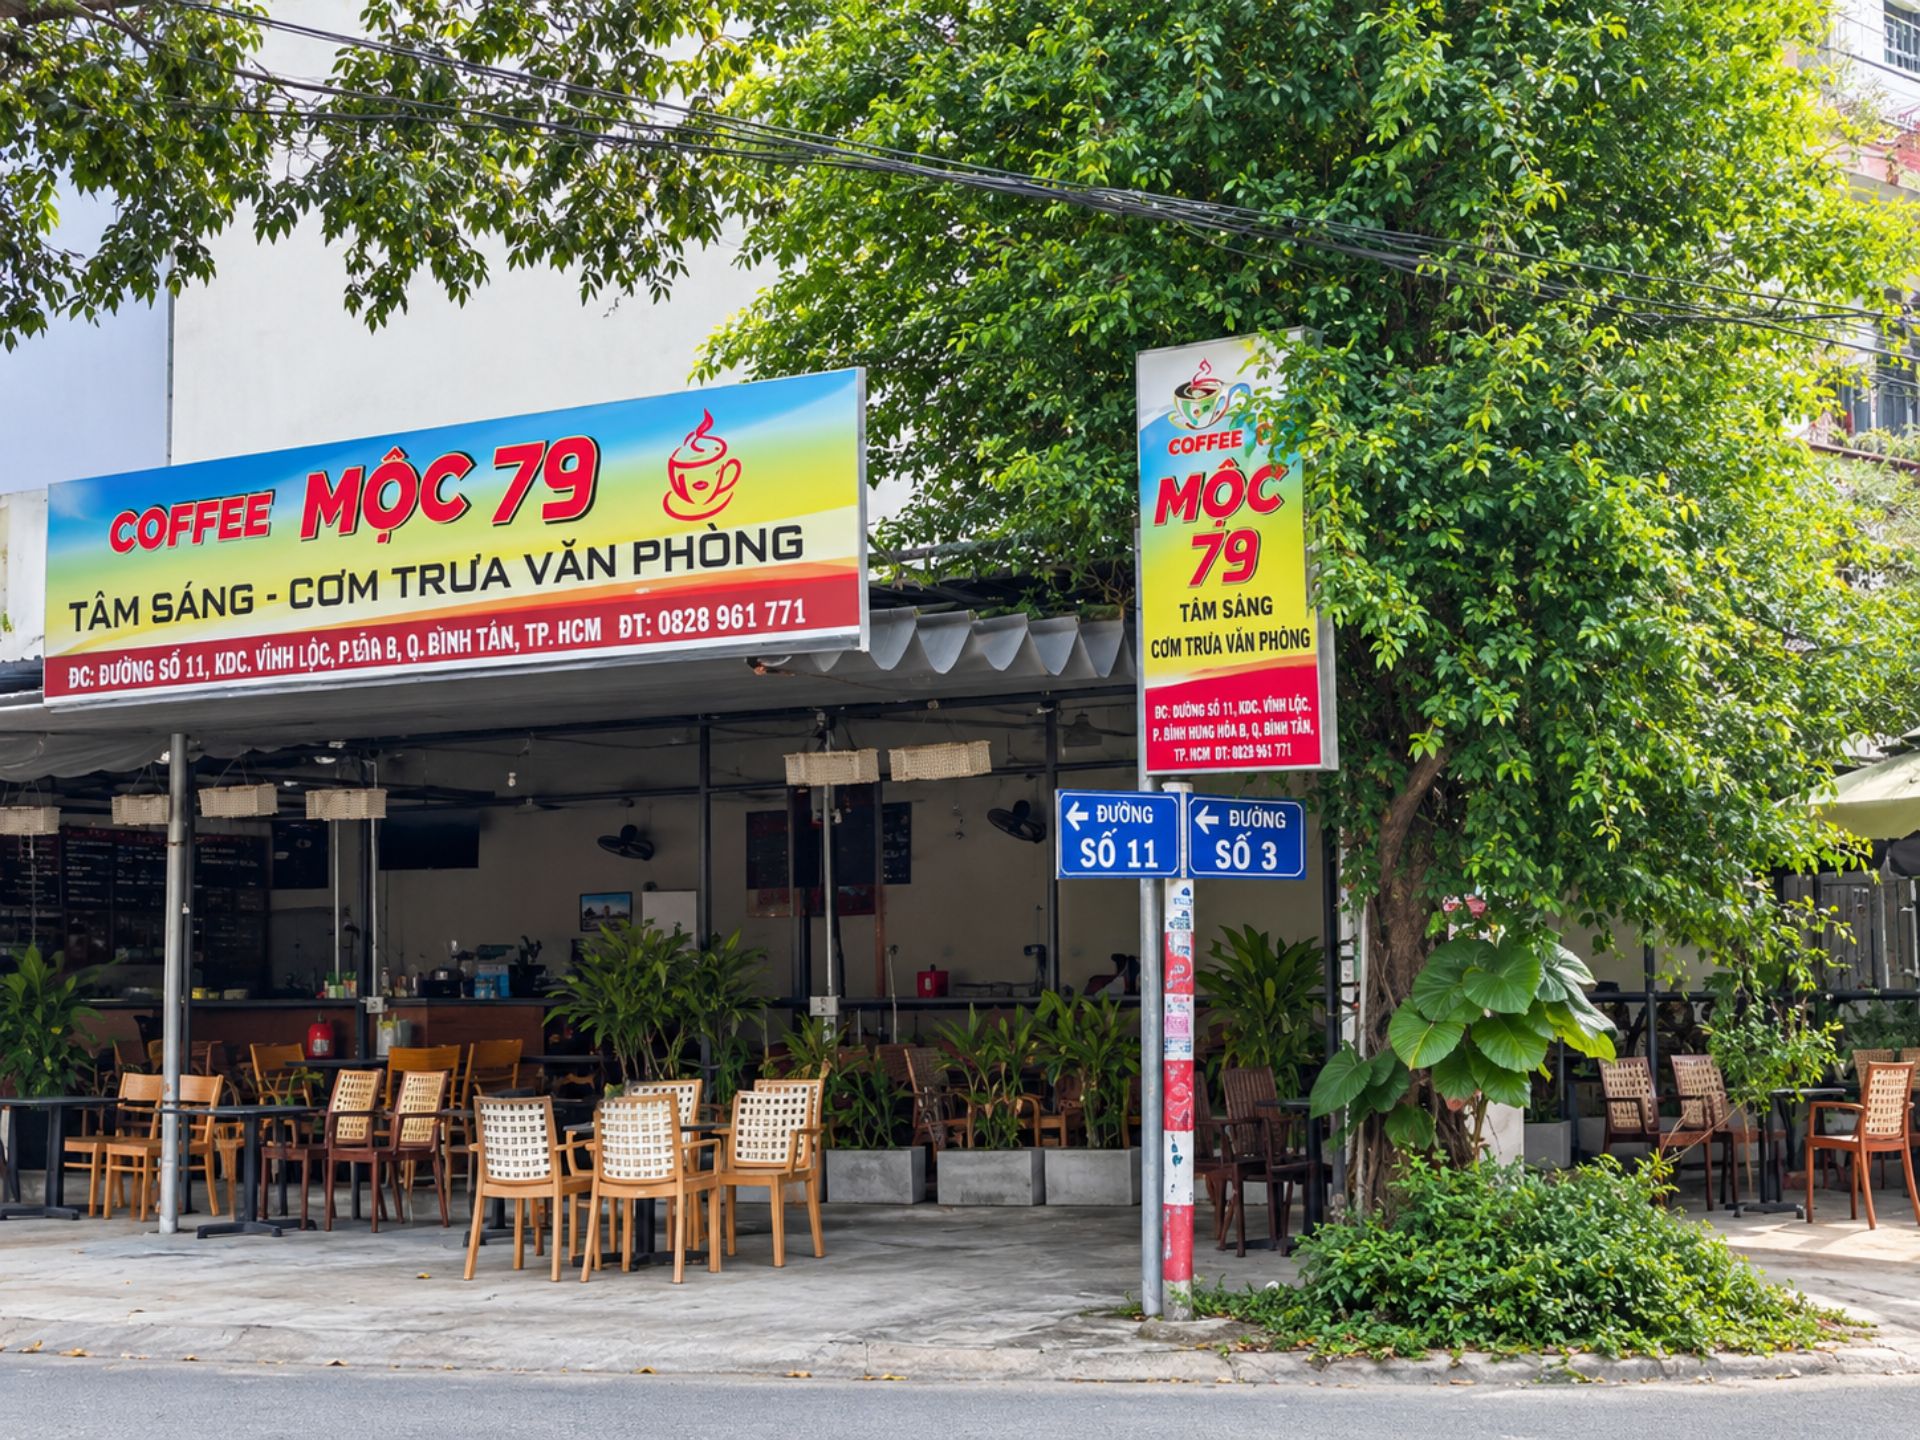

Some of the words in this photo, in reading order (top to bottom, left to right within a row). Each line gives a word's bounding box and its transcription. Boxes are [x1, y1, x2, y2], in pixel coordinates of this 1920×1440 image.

[1168, 430, 1243, 456] COFFEE
[109, 489, 276, 554] COFFEE
[300, 446, 477, 544] MỘC
[491, 435, 600, 526] 79
[1154, 458, 1289, 528] MỘC
[69, 590, 140, 632] TÂM
[151, 581, 254, 623] SÁNG
[289, 569, 378, 609] CƠM
[392, 553, 511, 597] TRƯA
[525, 538, 616, 586] VĂN
[633, 523, 804, 574] PHÒNG
[1189, 527, 1261, 588] 79
[1179, 597, 1217, 622] TÂM
[68, 666, 94, 689] ĐC:
[99, 656, 154, 686] ĐƯỜNG
[159, 649, 181, 680] SỐ
[186, 654, 210, 680] 11,
[215, 650, 251, 675] KDC.
[525, 622, 553, 647] TP.
[558, 617, 601, 644] HCM
[619, 613, 651, 639] ĐT:
[658, 607, 709, 636] 0828
[716, 603, 757, 630] 961
[764, 598, 806, 626] 771
[1151, 636, 1181, 659] CƠM
[1225, 627, 1254, 653] VĂN
[1096, 801, 1153, 824] ĐƯỜNG
[1229, 806, 1287, 829] ĐƯỜNG
[1080, 828, 1117, 869] SỐ
[1127, 839, 1159, 868] 11
[1215, 831, 1252, 870] SỐ
[1261, 842, 1277, 871] 3
